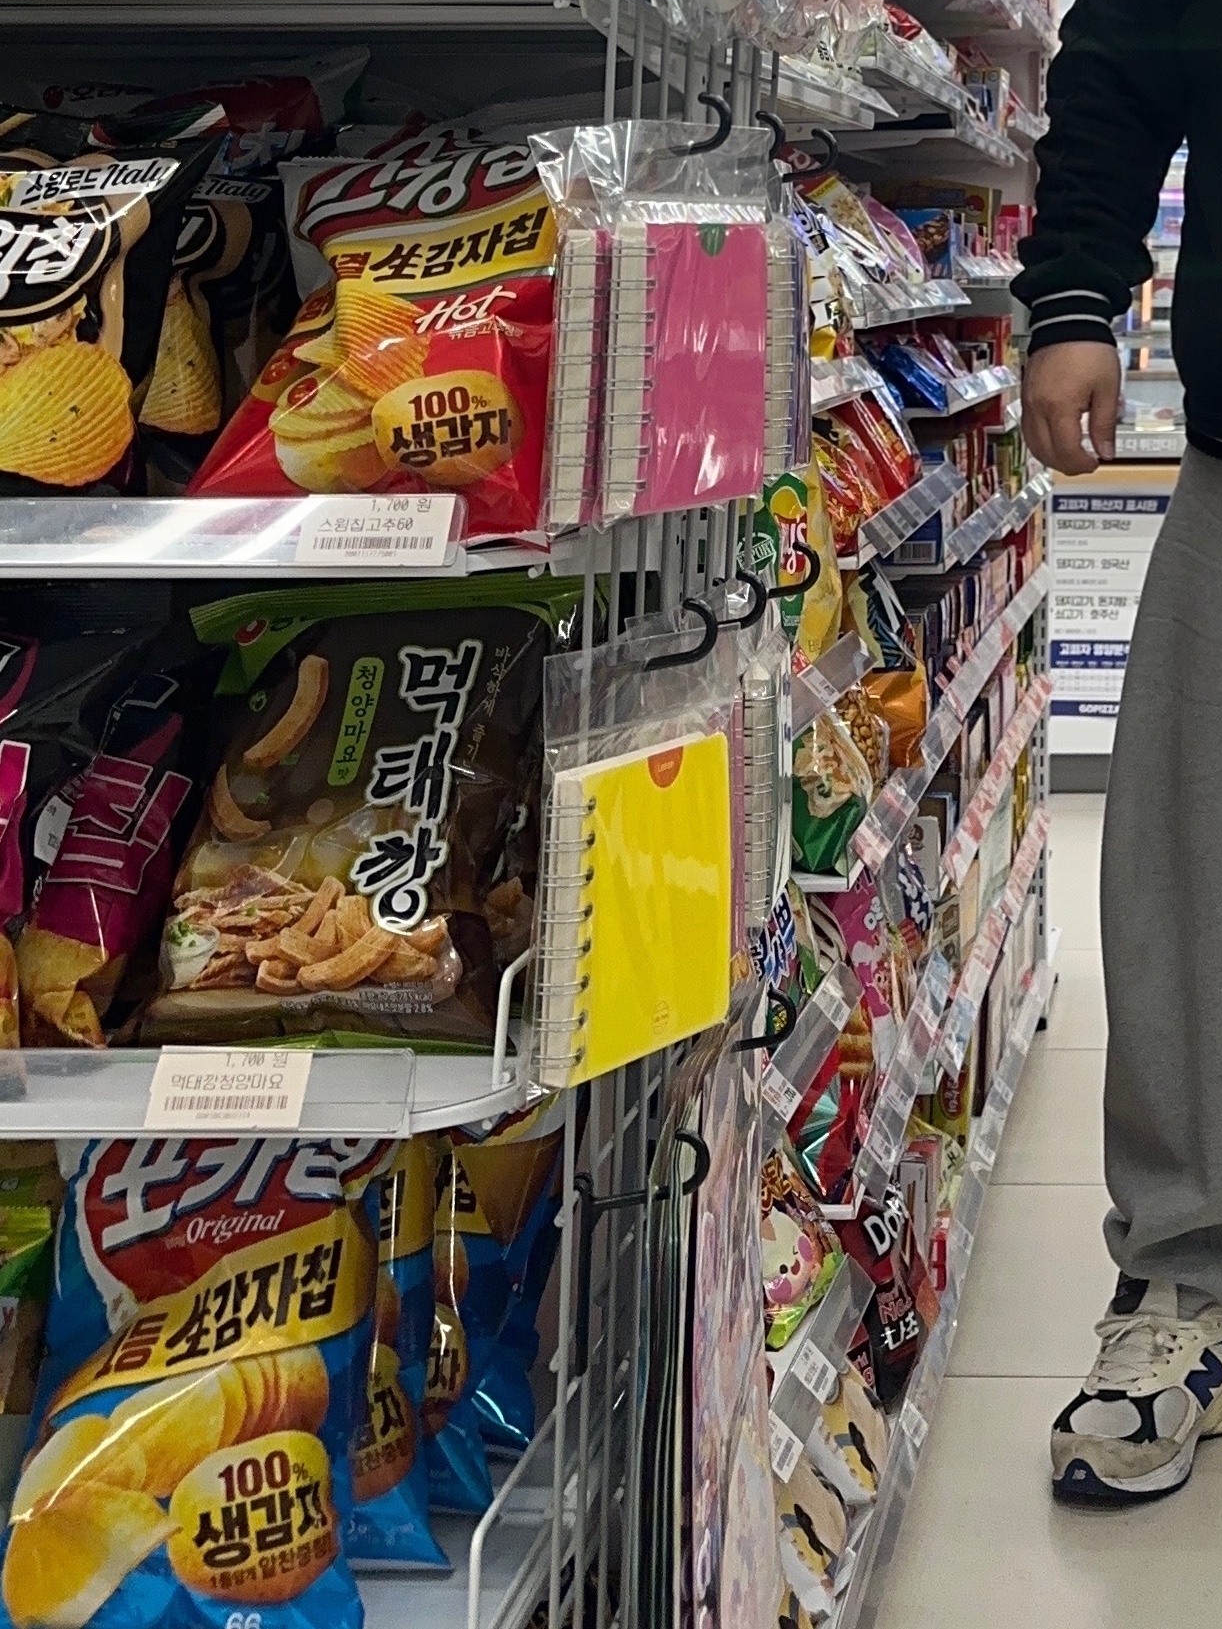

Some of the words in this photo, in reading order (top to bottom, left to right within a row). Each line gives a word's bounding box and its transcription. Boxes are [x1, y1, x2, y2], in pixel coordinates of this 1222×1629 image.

[20, 169, 99, 206] 스윙로드
[99, 159, 174, 191] Italy
[415, 285, 518, 333] Hot
[408, 385, 488, 423] 100%
[390, 407, 514, 470] 생감자
[317, 515, 415, 533] 스윙칩고추60
[370, 496, 410, 513] 1,700
[417, 496, 432, 513] 원
[352, 642, 481, 932] 먹태깡
[225, 1052, 266, 1069] 1,700
[273, 1052, 289, 1069] 원
[171, 1073, 284, 1091] 먹태깡청양마요
[186, 1210, 286, 1244] Original
[218, 1449, 313, 1503] 100%
[194, 1481, 328, 1569] 생감자
